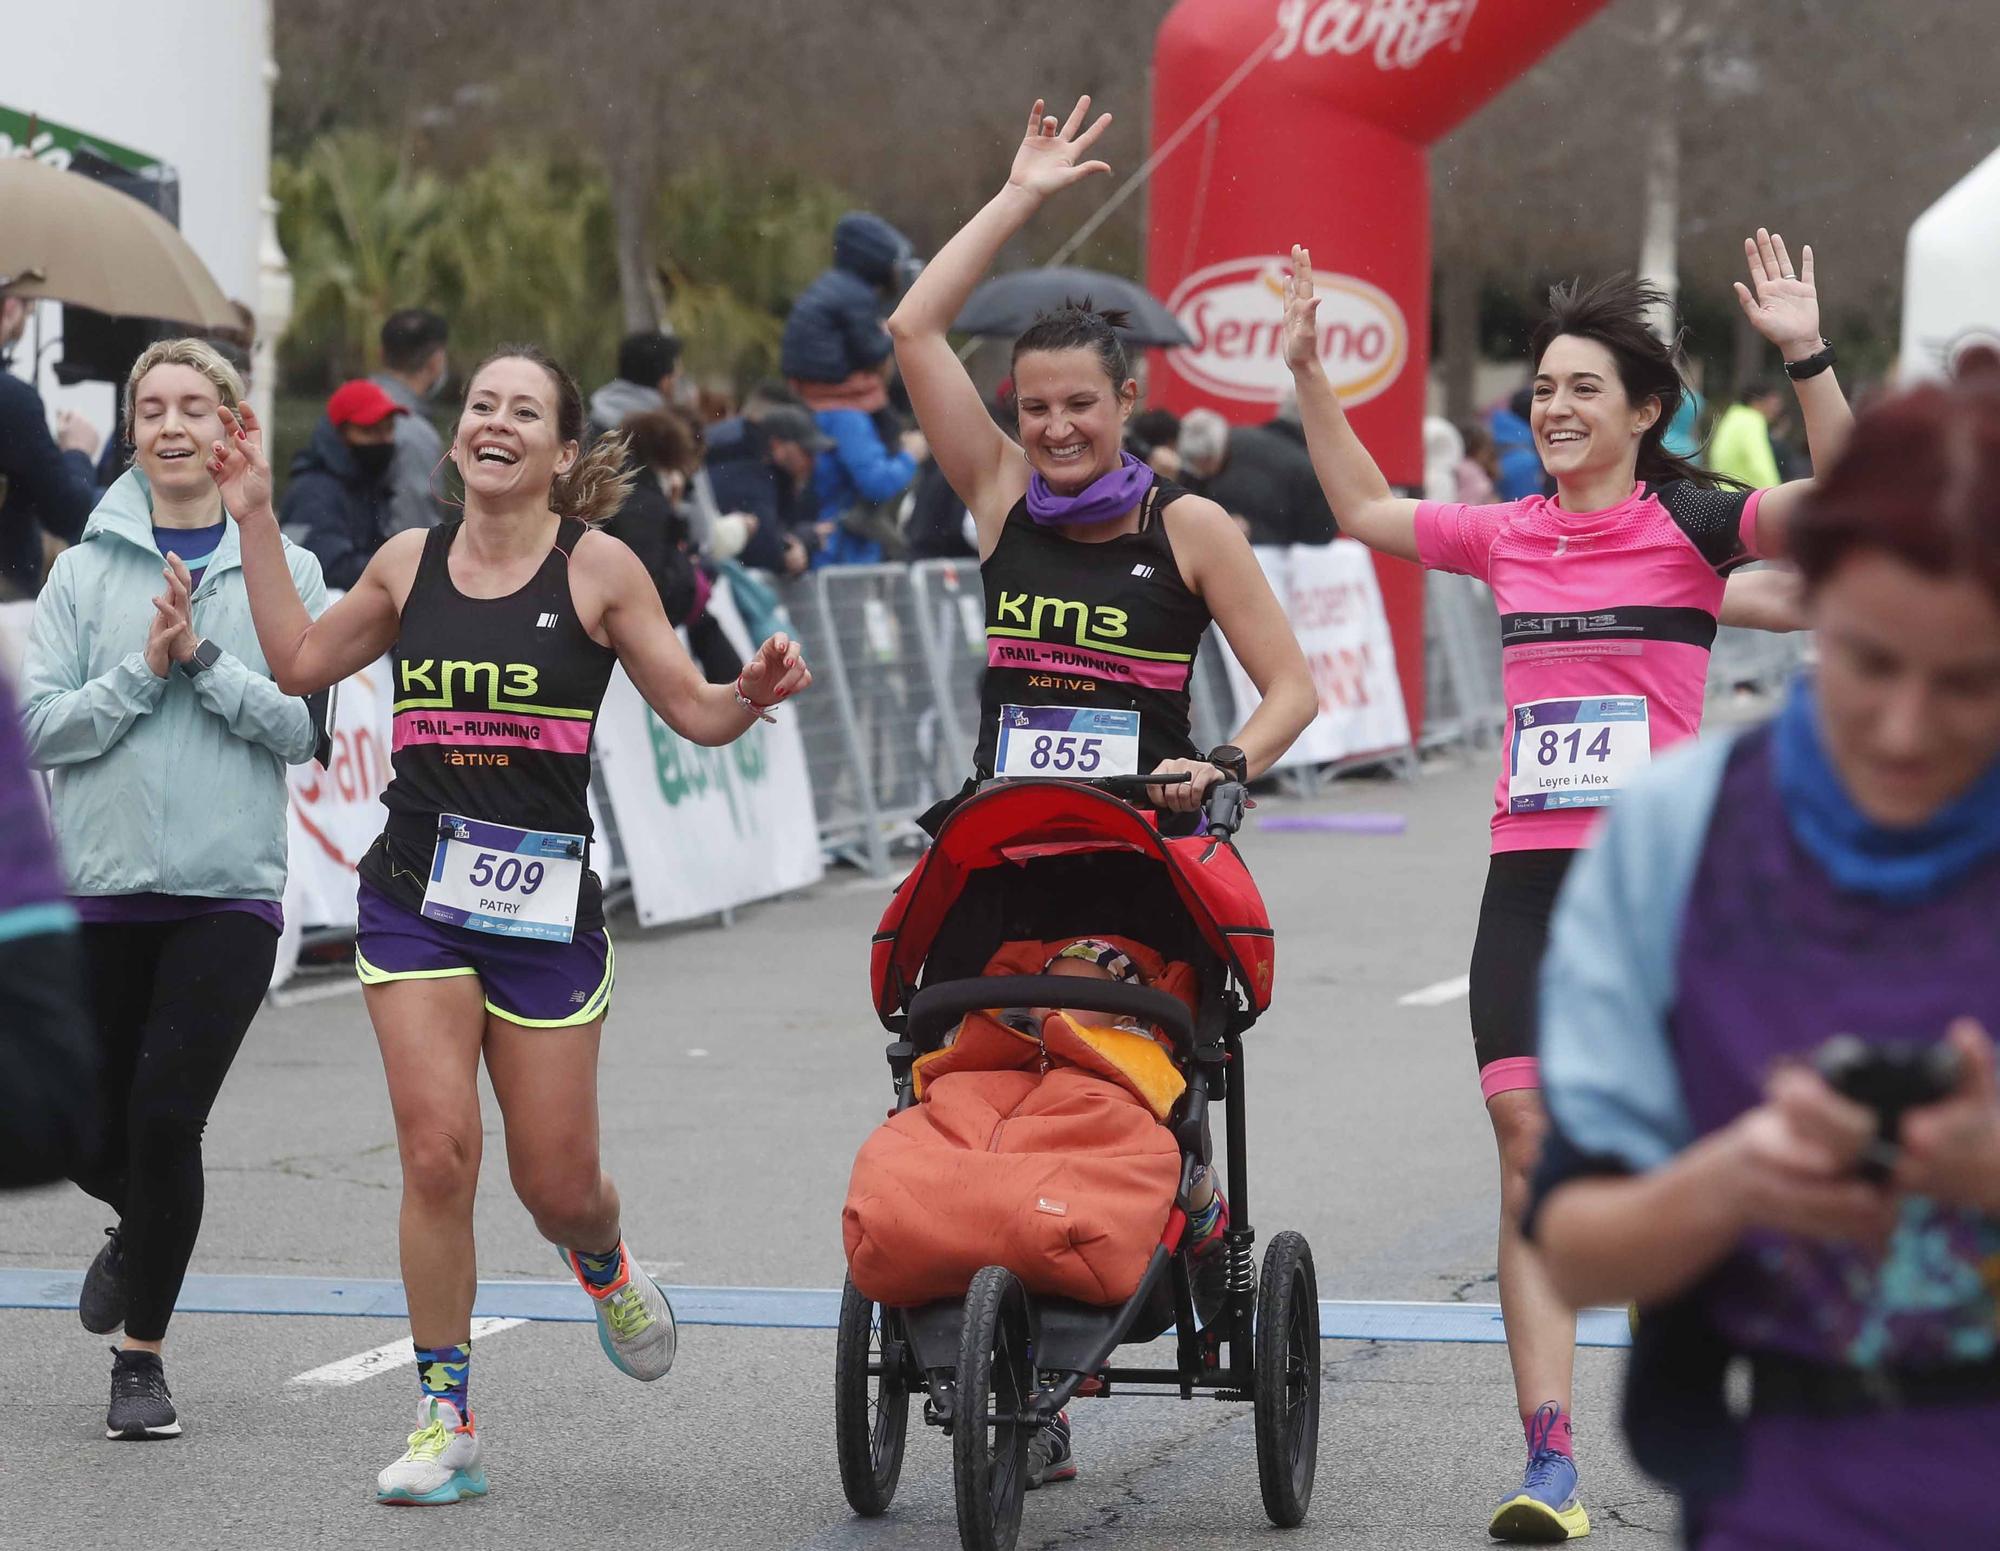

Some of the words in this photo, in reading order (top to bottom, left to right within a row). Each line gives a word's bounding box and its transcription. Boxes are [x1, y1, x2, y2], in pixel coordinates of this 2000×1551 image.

[1188, 300, 1385, 362] Serrno
[998, 646, 1130, 675] TRAIL-RUNNING
[1030, 735, 1103, 773] 855
[1537, 727, 1612, 765] 814
[1539, 775, 1570, 788] Leyre
[1574, 775, 1578, 786] i
[1582, 774, 1609, 785] Alex
[469, 854, 545, 895] 509
[480, 897, 521, 914] PATRY
